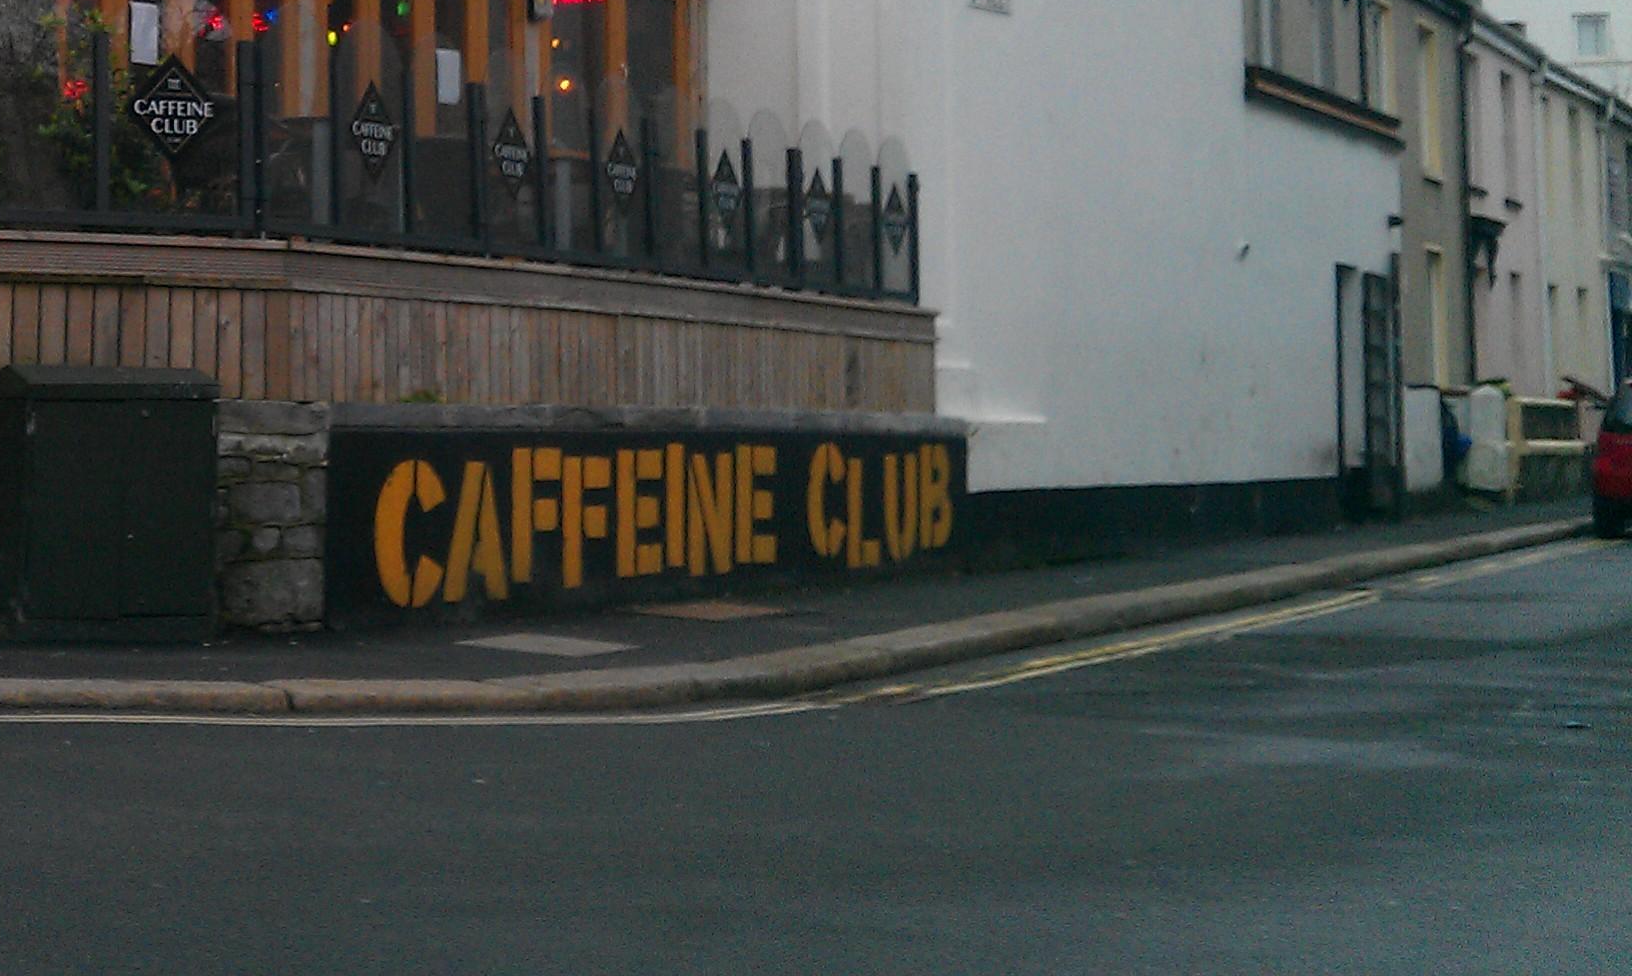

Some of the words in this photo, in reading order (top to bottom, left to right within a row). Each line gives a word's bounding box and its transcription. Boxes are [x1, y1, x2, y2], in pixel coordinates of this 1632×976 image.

[133, 99, 214, 117] CAFFEINE
[151, 117, 198, 135] CLUB
[374, 442, 777, 609] CAFFEINE
[805, 441, 953, 569] CLUB
